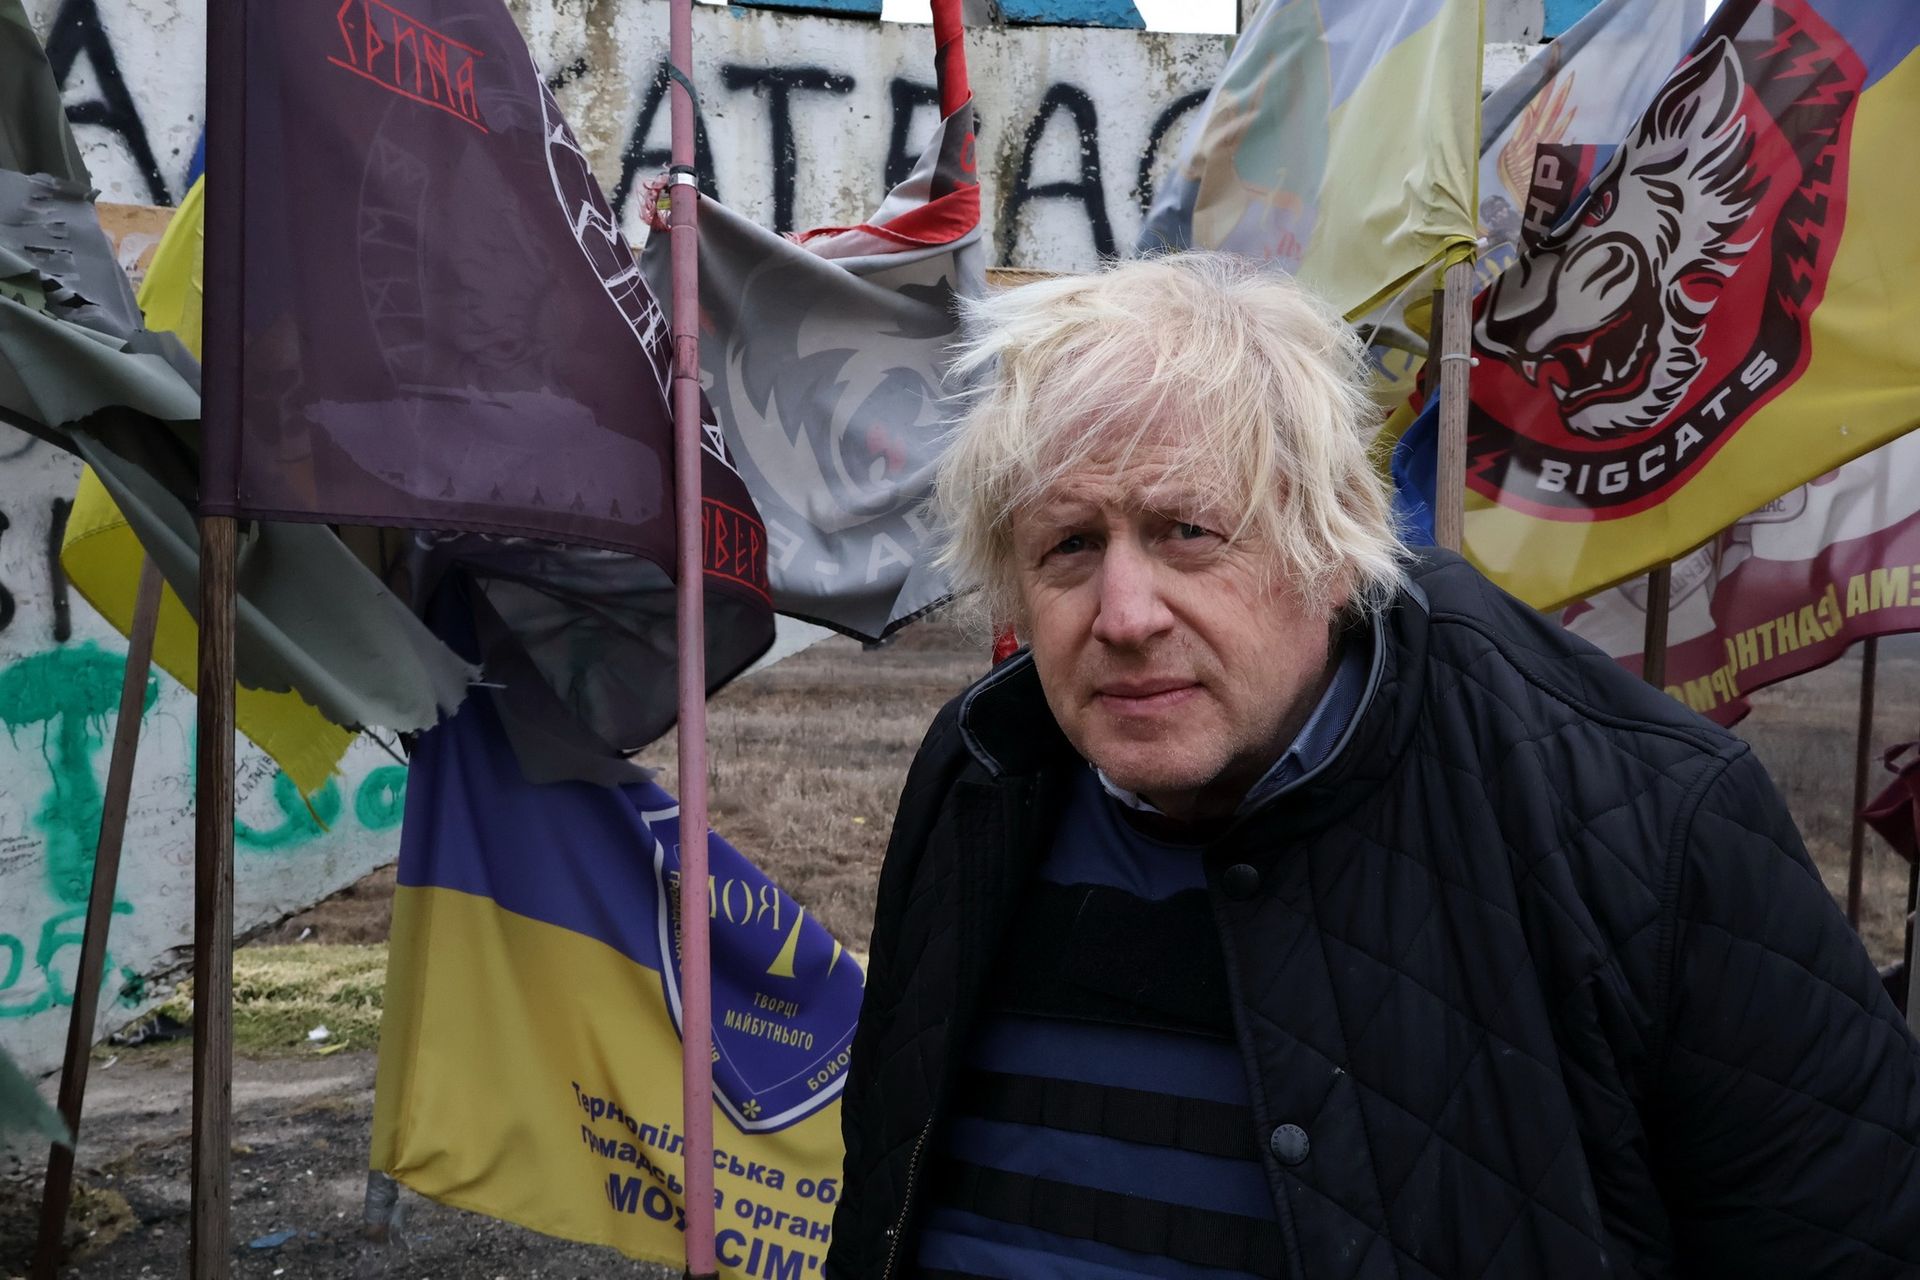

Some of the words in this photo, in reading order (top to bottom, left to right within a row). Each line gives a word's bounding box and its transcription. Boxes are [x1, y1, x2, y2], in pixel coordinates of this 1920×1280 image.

[1536, 350, 1779, 495] BIGCATS
[723, 1009, 814, 1051] МАЙБУТНЬОГО
[753, 992, 799, 1019] ТВОРЦІ
[571, 1080, 786, 1191] Тернопілська
[796, 1178, 839, 1205] об
[714, 1228, 827, 1280] СІМ'
